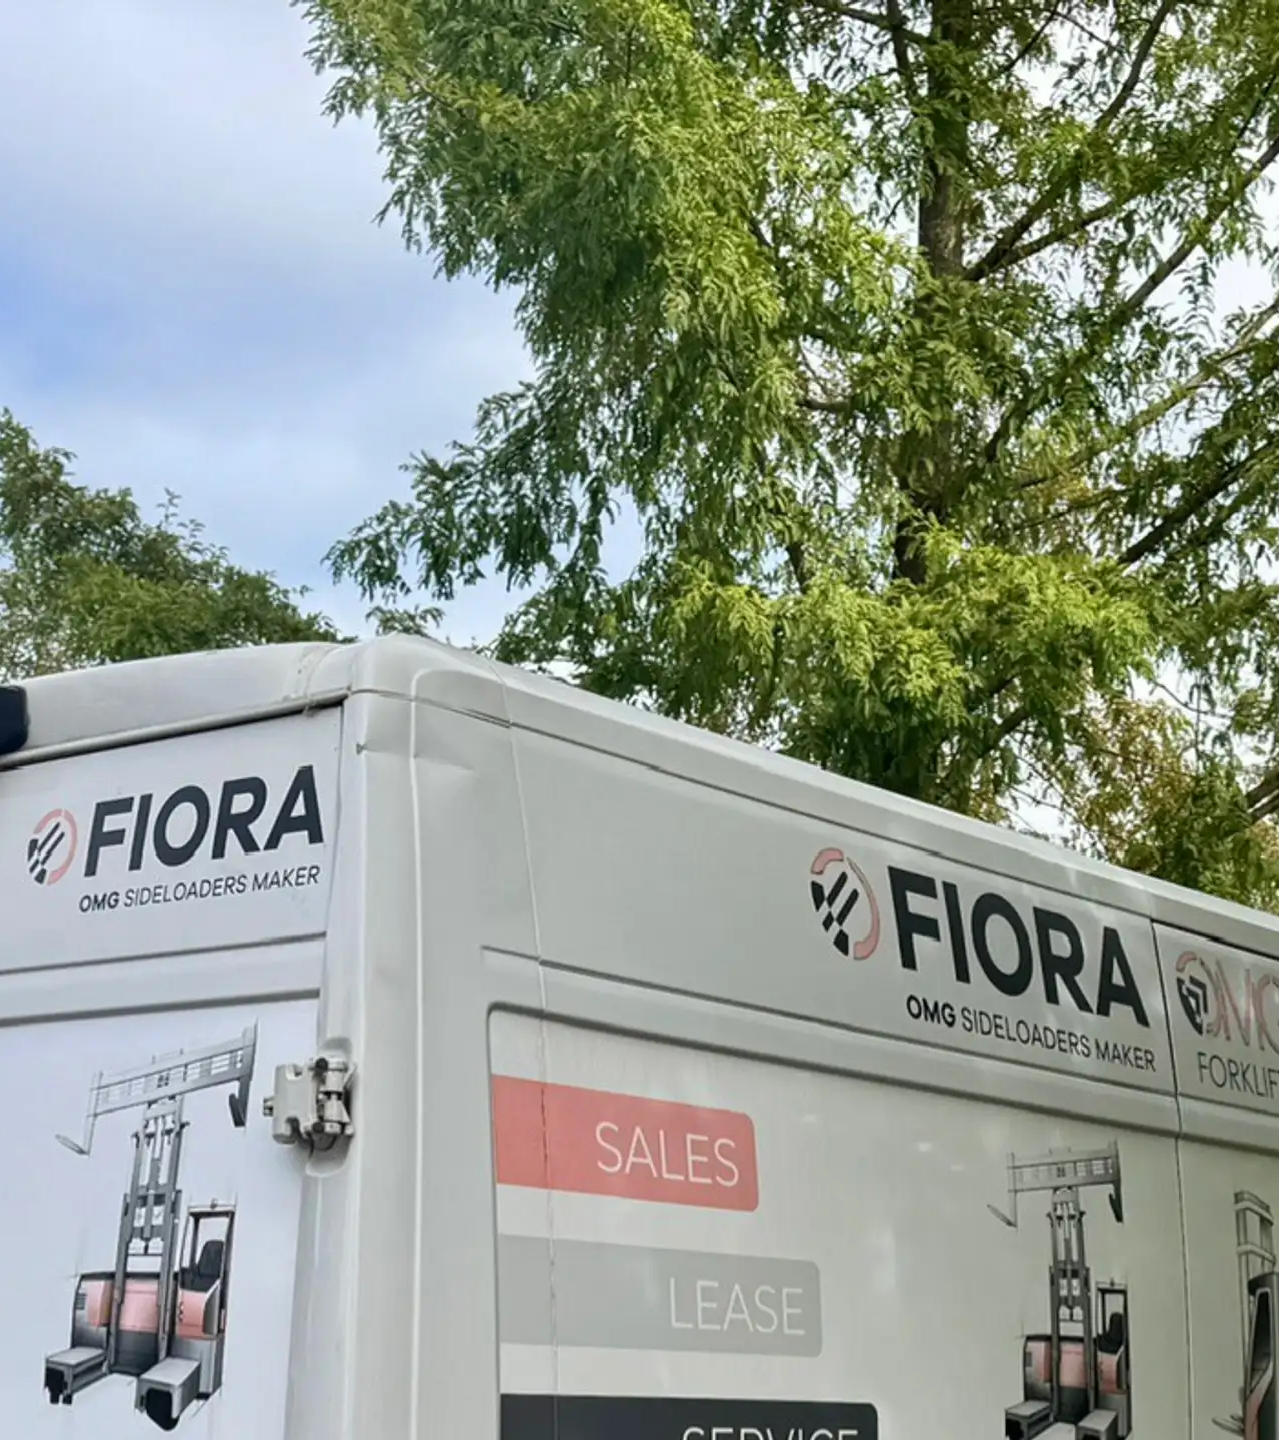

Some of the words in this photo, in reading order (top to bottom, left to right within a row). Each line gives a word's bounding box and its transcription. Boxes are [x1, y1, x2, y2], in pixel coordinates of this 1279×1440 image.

[84, 765, 324, 878] FIORA
[78, 891, 120, 912] OMG
[124, 874, 247, 908] SIDELOADERS
[251, 865, 321, 892] MAKER
[887, 865, 1151, 1028] FIORA
[906, 994, 956, 1028] OMG
[960, 1007, 1092, 1059] SIDELOADERS
[1096, 1039, 1157, 1072] MAKER
[594, 1121, 740, 1187] SALES
[669, 1277, 806, 1336] LEASE
